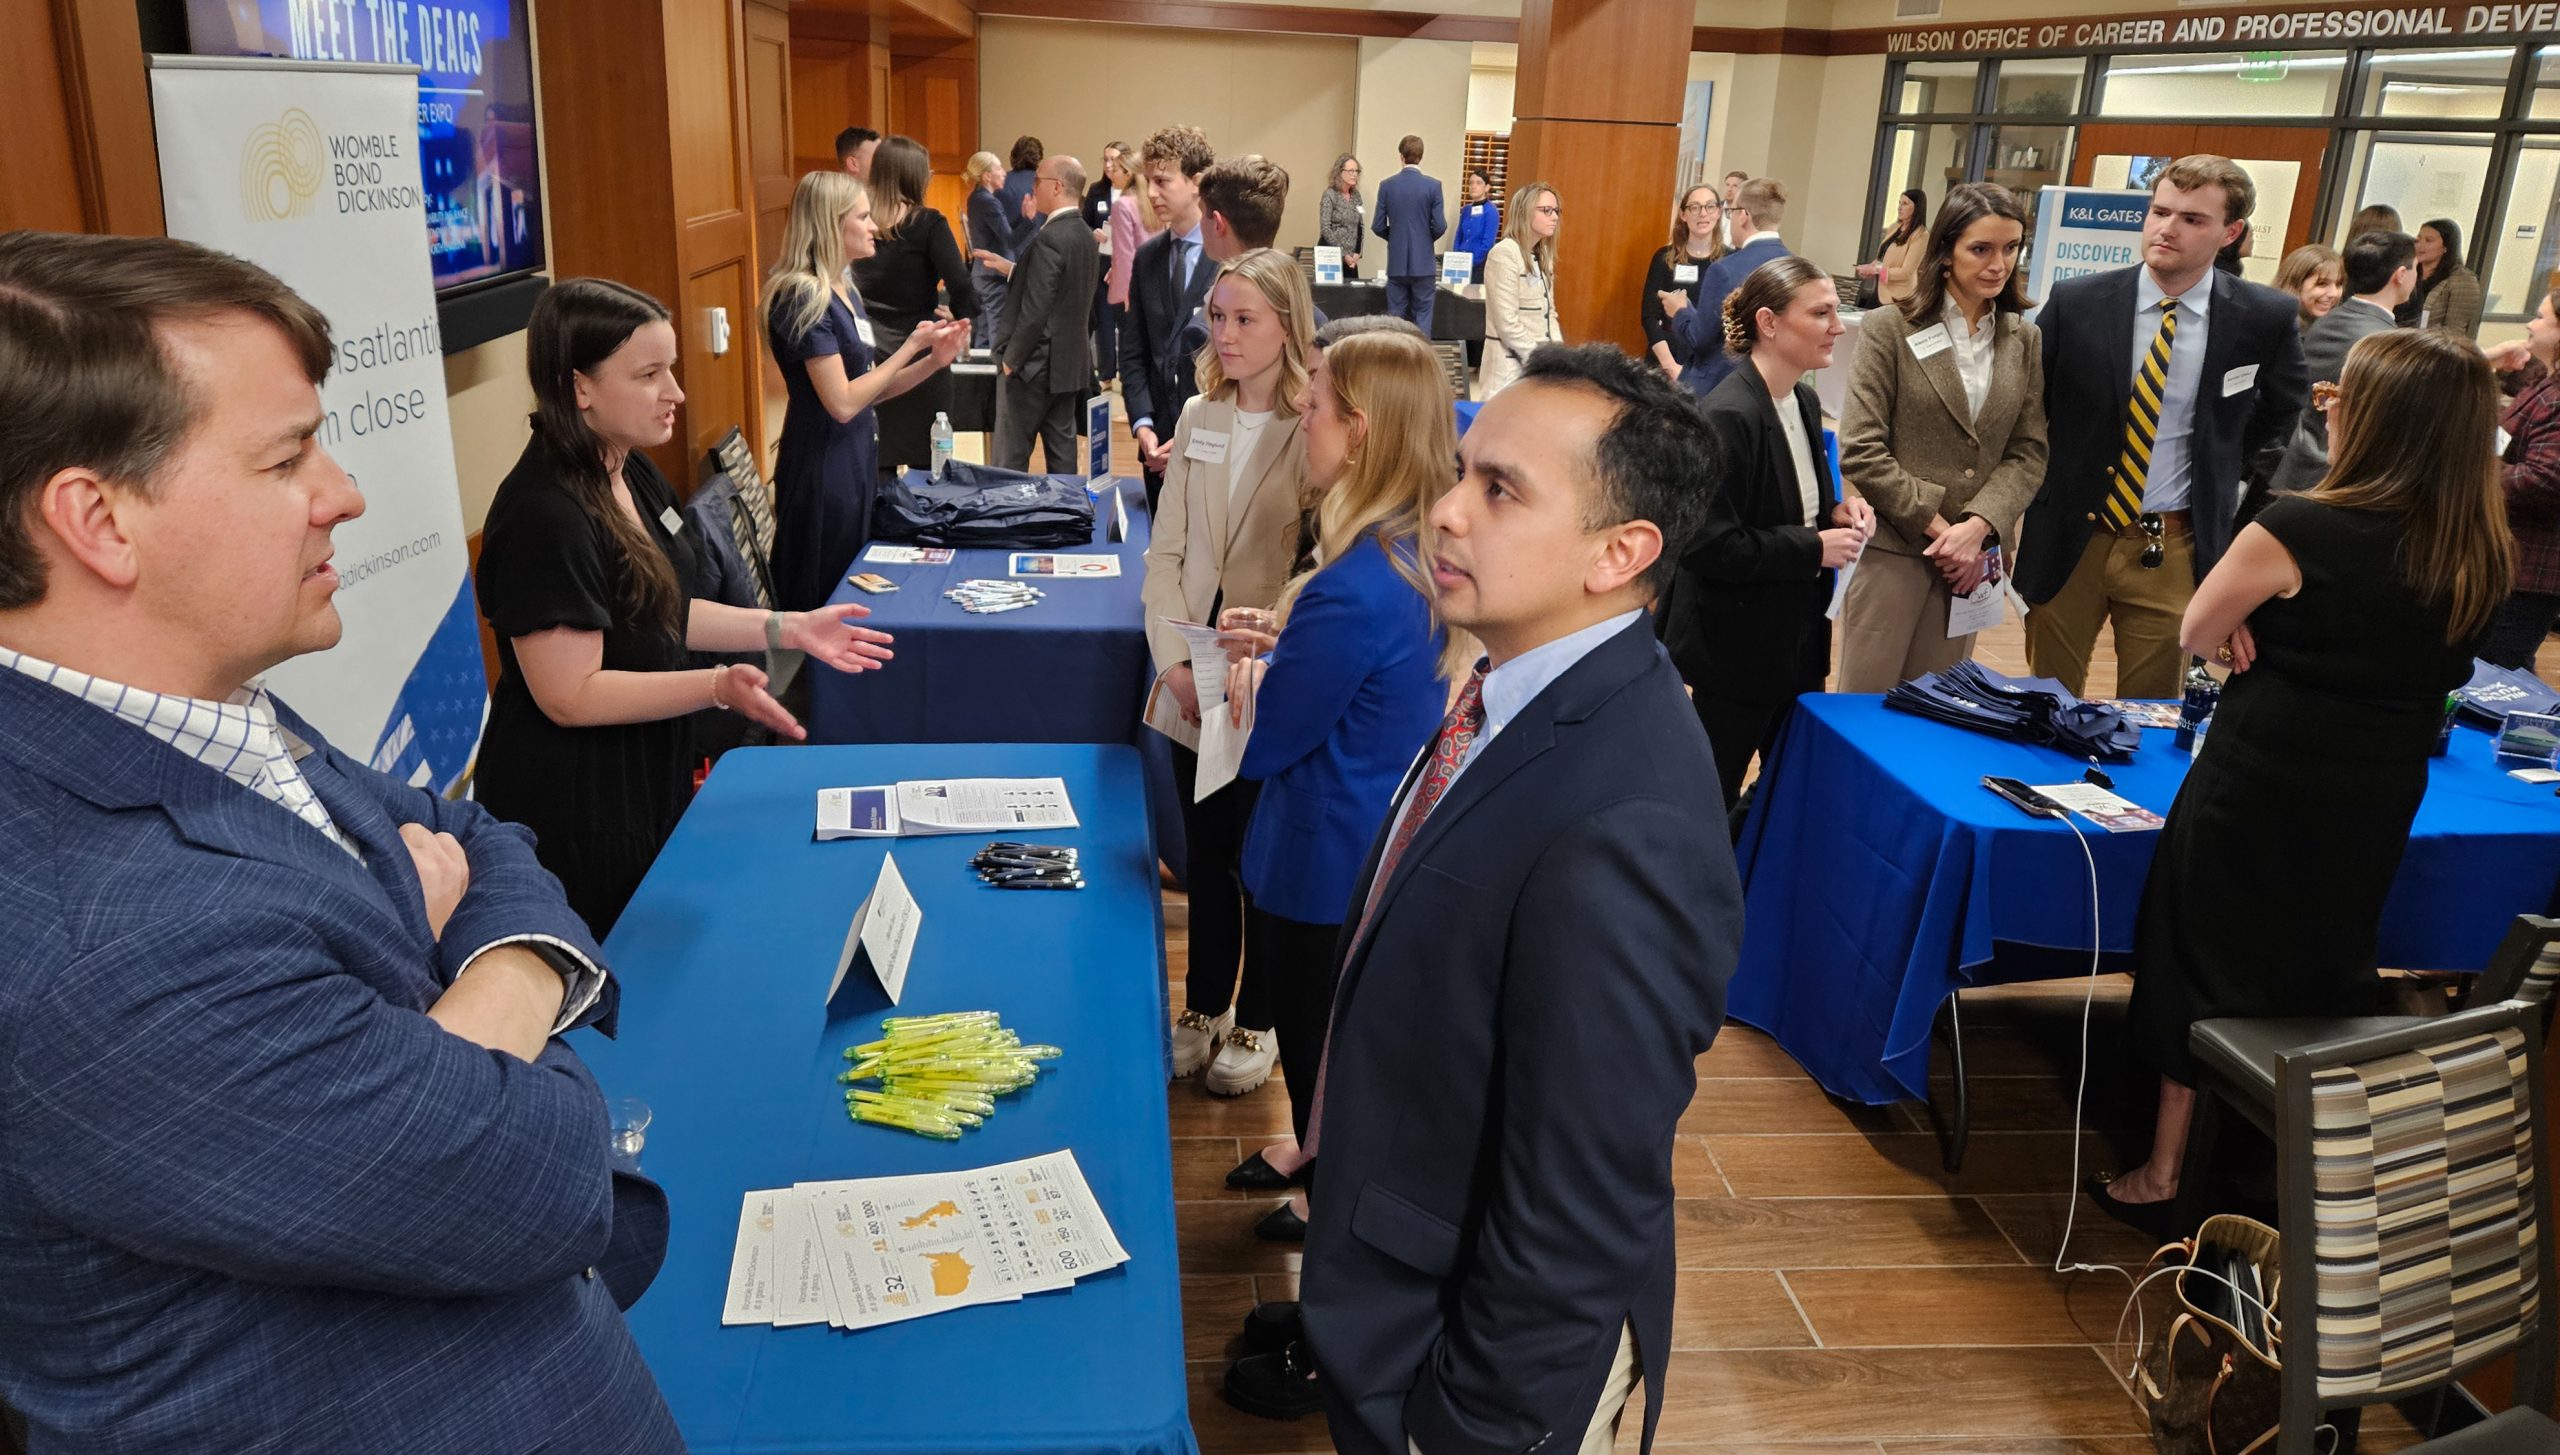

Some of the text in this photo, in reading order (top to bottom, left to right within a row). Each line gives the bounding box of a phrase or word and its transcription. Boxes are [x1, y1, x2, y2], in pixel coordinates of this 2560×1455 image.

[288, 0, 482, 76] MEET THE DEACS
[1887, 3, 2560, 52] WILSON OFFICE OF CAREER AND PROFESSIONAL DEVE
[430, 103, 453, 123] EXPO
[328, 135, 399, 159] WOMBLE
[334, 162, 382, 187] BOND
[338, 186, 421, 213] DICKINSON
[2069, 207, 2142, 223] K&L GATES
[2056, 242, 2135, 264] DISCOVER.
[350, 388, 425, 436] close
[1058, 1250, 1078, 1270] 600
[885, 1275, 904, 1293] 32
